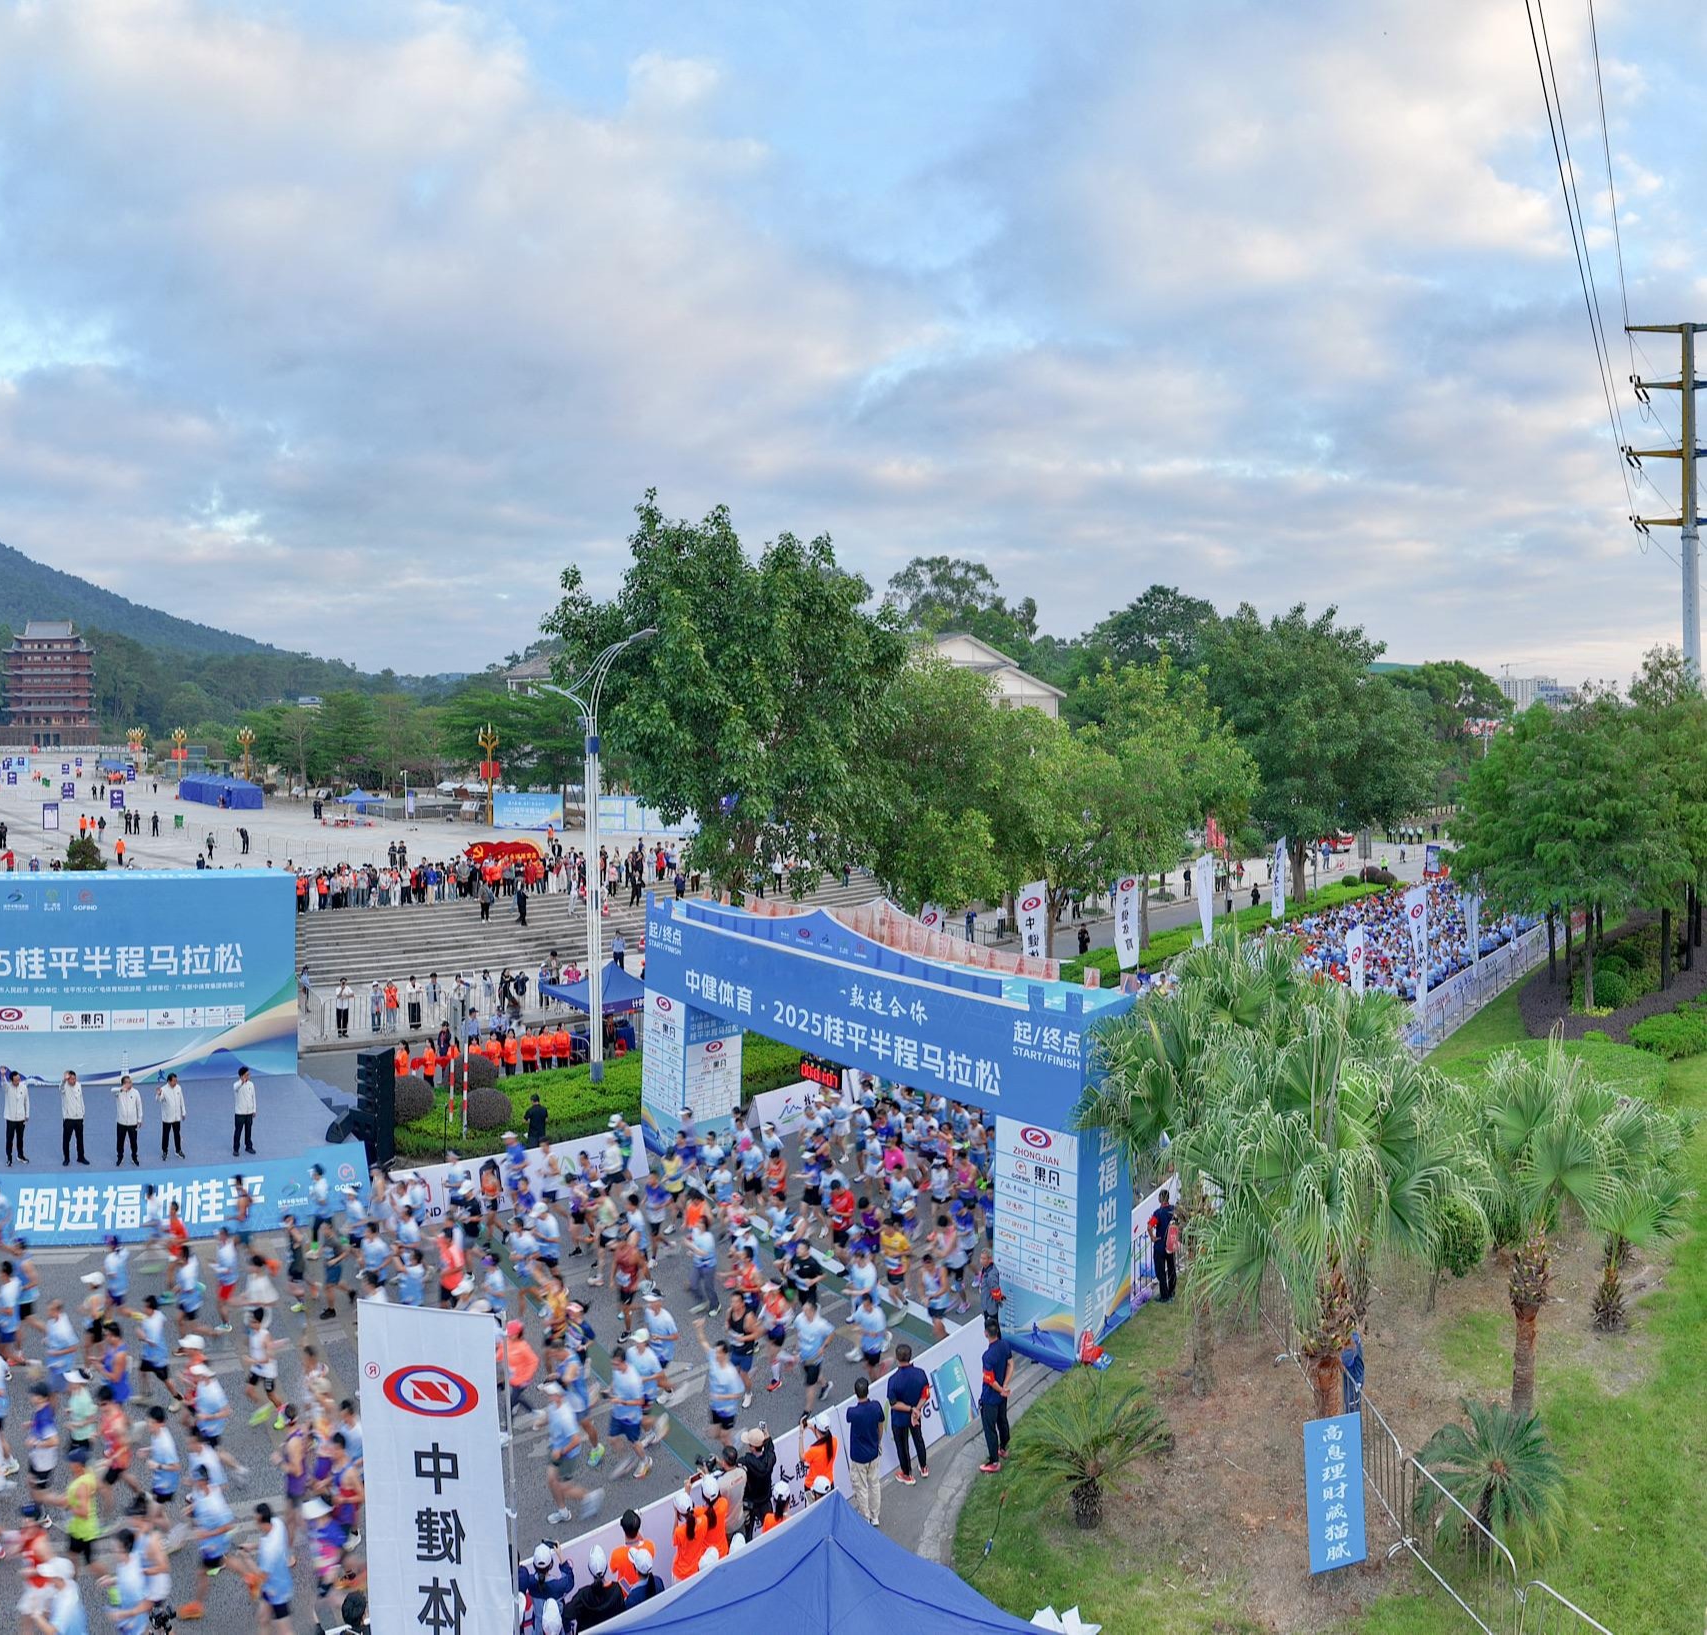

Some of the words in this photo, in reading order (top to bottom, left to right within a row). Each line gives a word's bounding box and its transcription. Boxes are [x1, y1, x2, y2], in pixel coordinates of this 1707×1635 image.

[648, 921, 682, 946] 起/终点
[1012, 1018, 1082, 1058] 起/终点
[1012, 1045, 1081, 1071] START/FINISH
[1012, 1146, 1060, 1167] ZHONGJIAN
[1320, 1423, 1352, 1563] 高息理财藏猫腻
